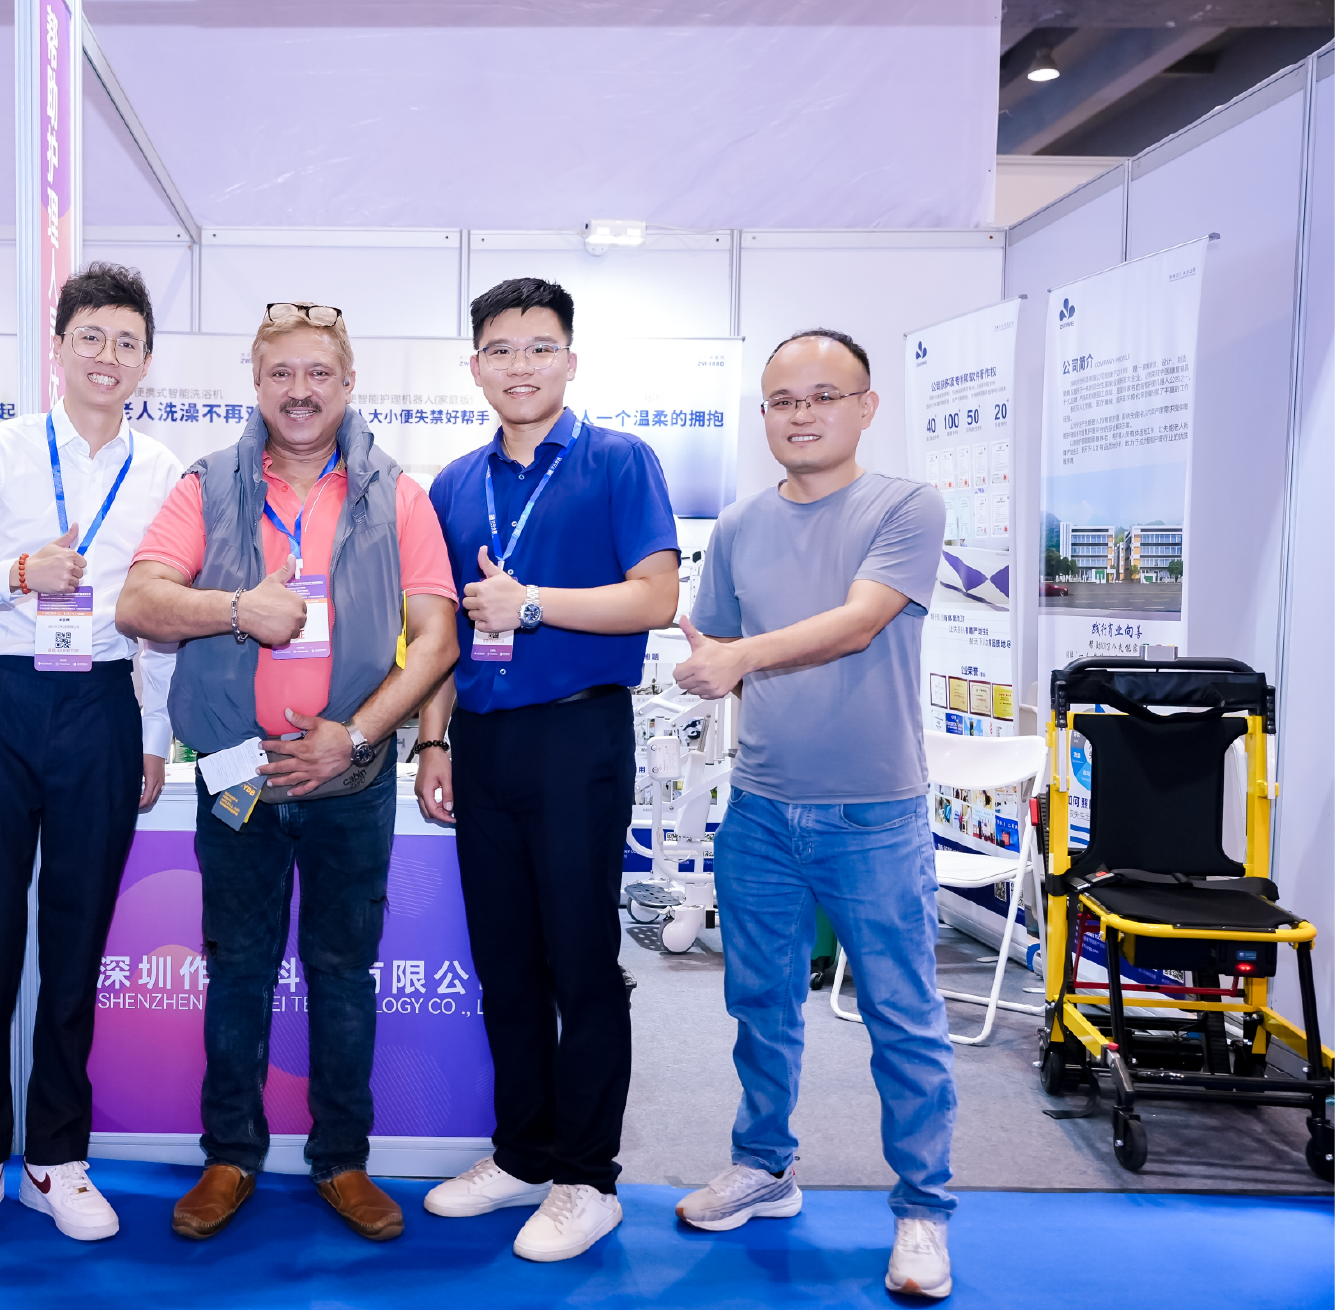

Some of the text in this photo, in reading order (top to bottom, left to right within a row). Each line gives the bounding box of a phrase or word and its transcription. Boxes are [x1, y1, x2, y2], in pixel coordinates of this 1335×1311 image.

[1063, 354, 1093, 375] 公司简介
[358, 409, 490, 425] 大小便失禁好帮手
[98, 993, 203, 1010] SHENZHEN
